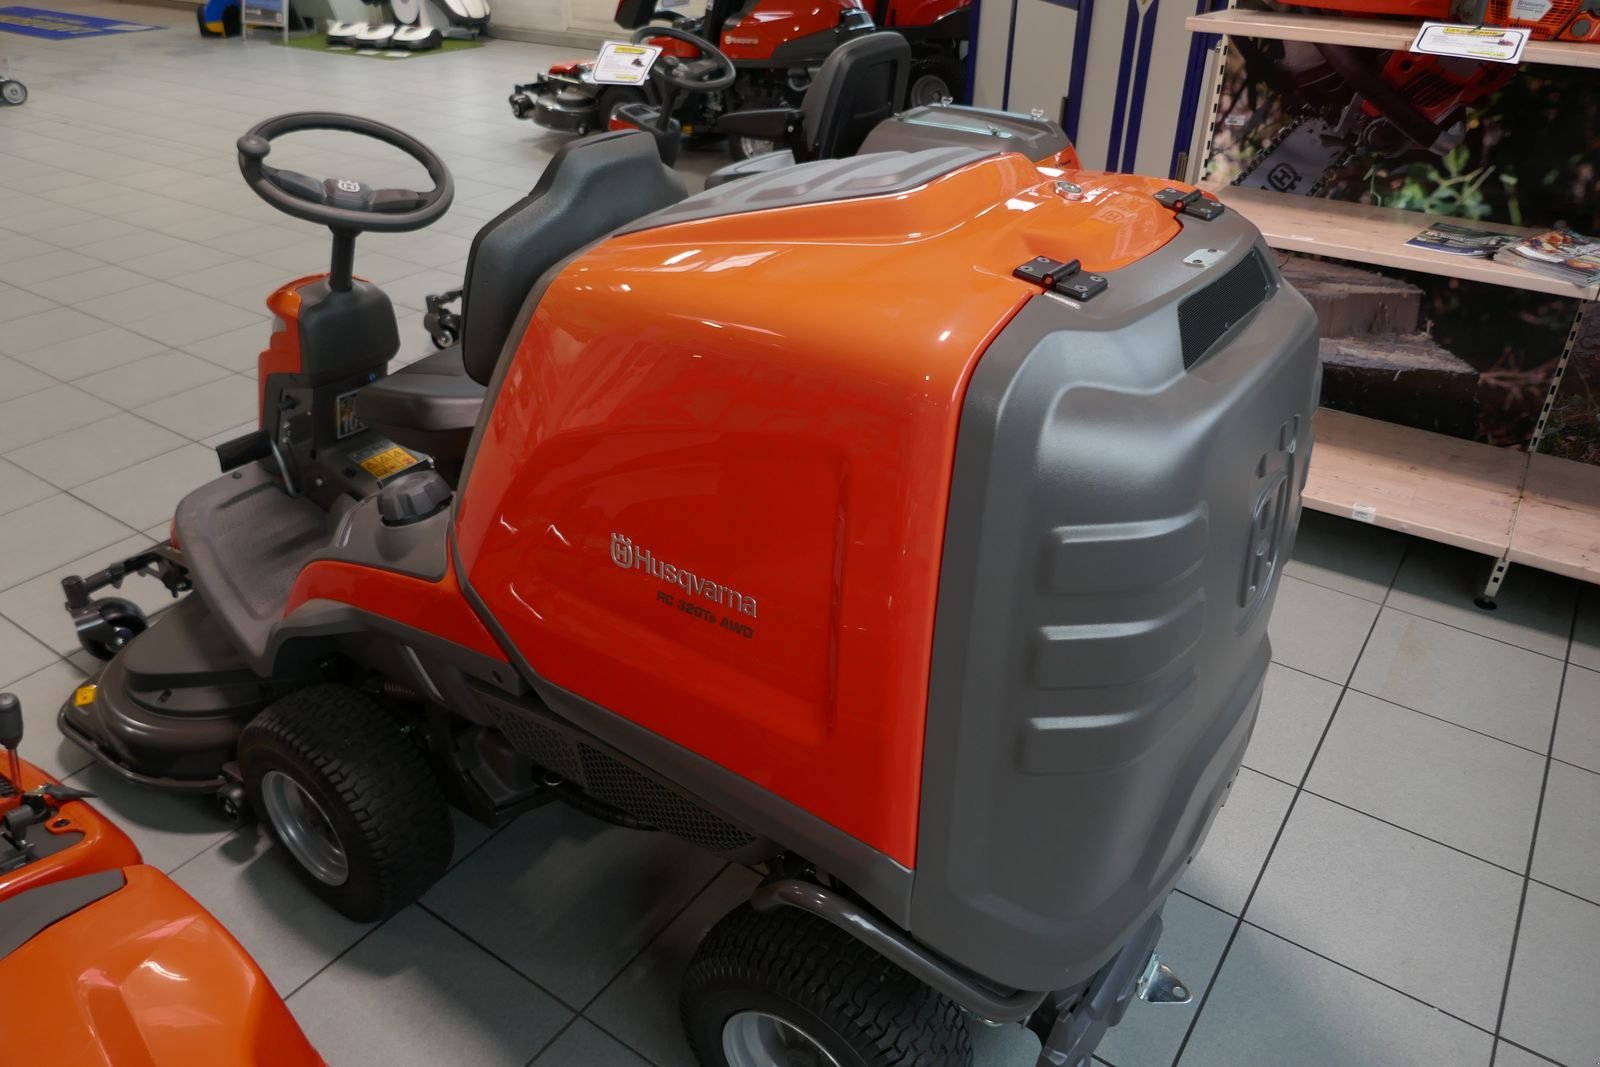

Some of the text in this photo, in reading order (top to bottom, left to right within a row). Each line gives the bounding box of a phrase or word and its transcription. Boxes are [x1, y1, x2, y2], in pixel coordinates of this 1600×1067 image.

[635, 545, 757, 618] Husqvarna
[656, 591, 673, 606] RC
[720, 618, 753, 638] AWD
